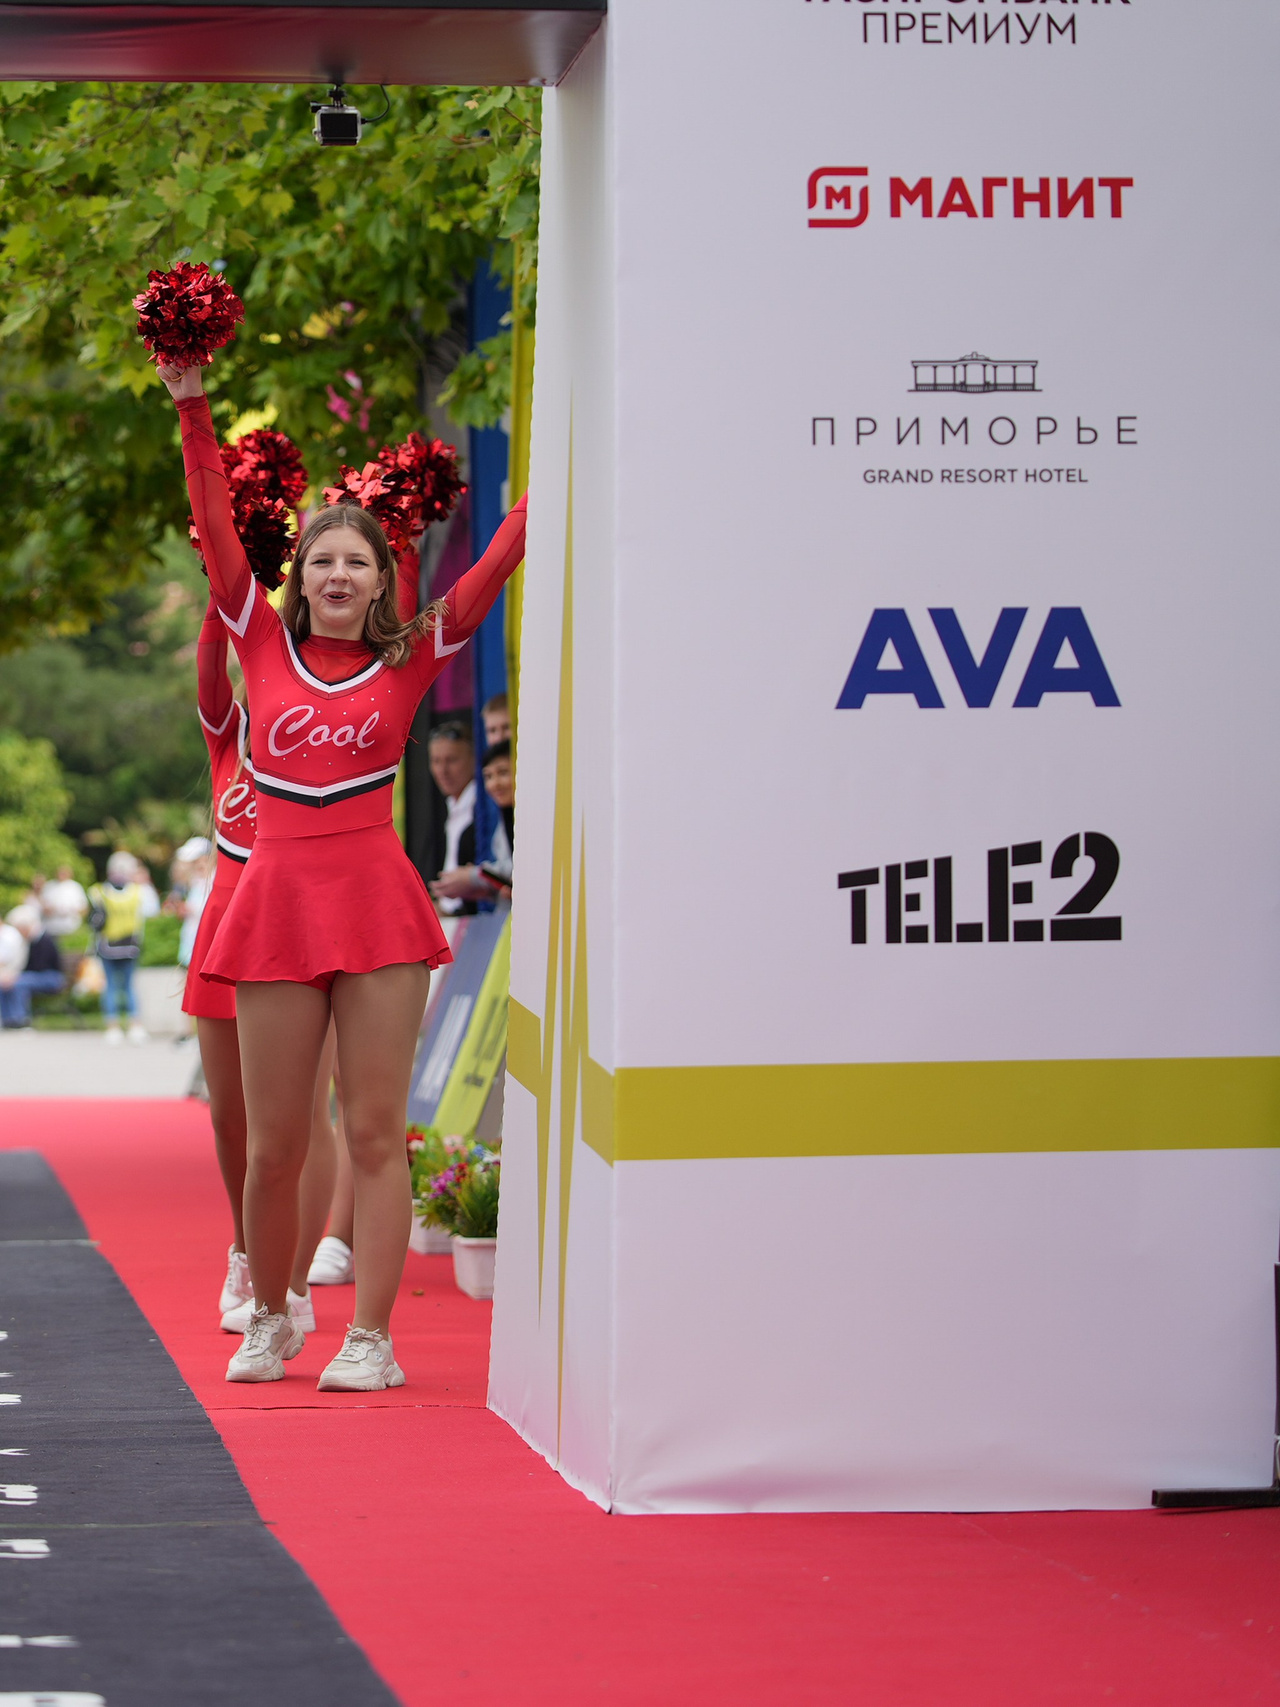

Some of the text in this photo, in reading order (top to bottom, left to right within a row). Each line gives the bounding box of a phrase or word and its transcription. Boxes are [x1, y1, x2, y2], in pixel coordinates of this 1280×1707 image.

[863, 12, 1076, 44] ПРЕМИУМ
[889, 177, 1134, 218] МАГНИТ
[811, 416, 1138, 446] ПРИМОРЬЕ
[863, 468, 1088, 484] GRAND RESORT HOTEL
[835, 606, 1122, 710] AVA
[268, 705, 380, 757] Cool
[217, 783, 257, 823] Co
[837, 831, 1122, 944] TELE2
